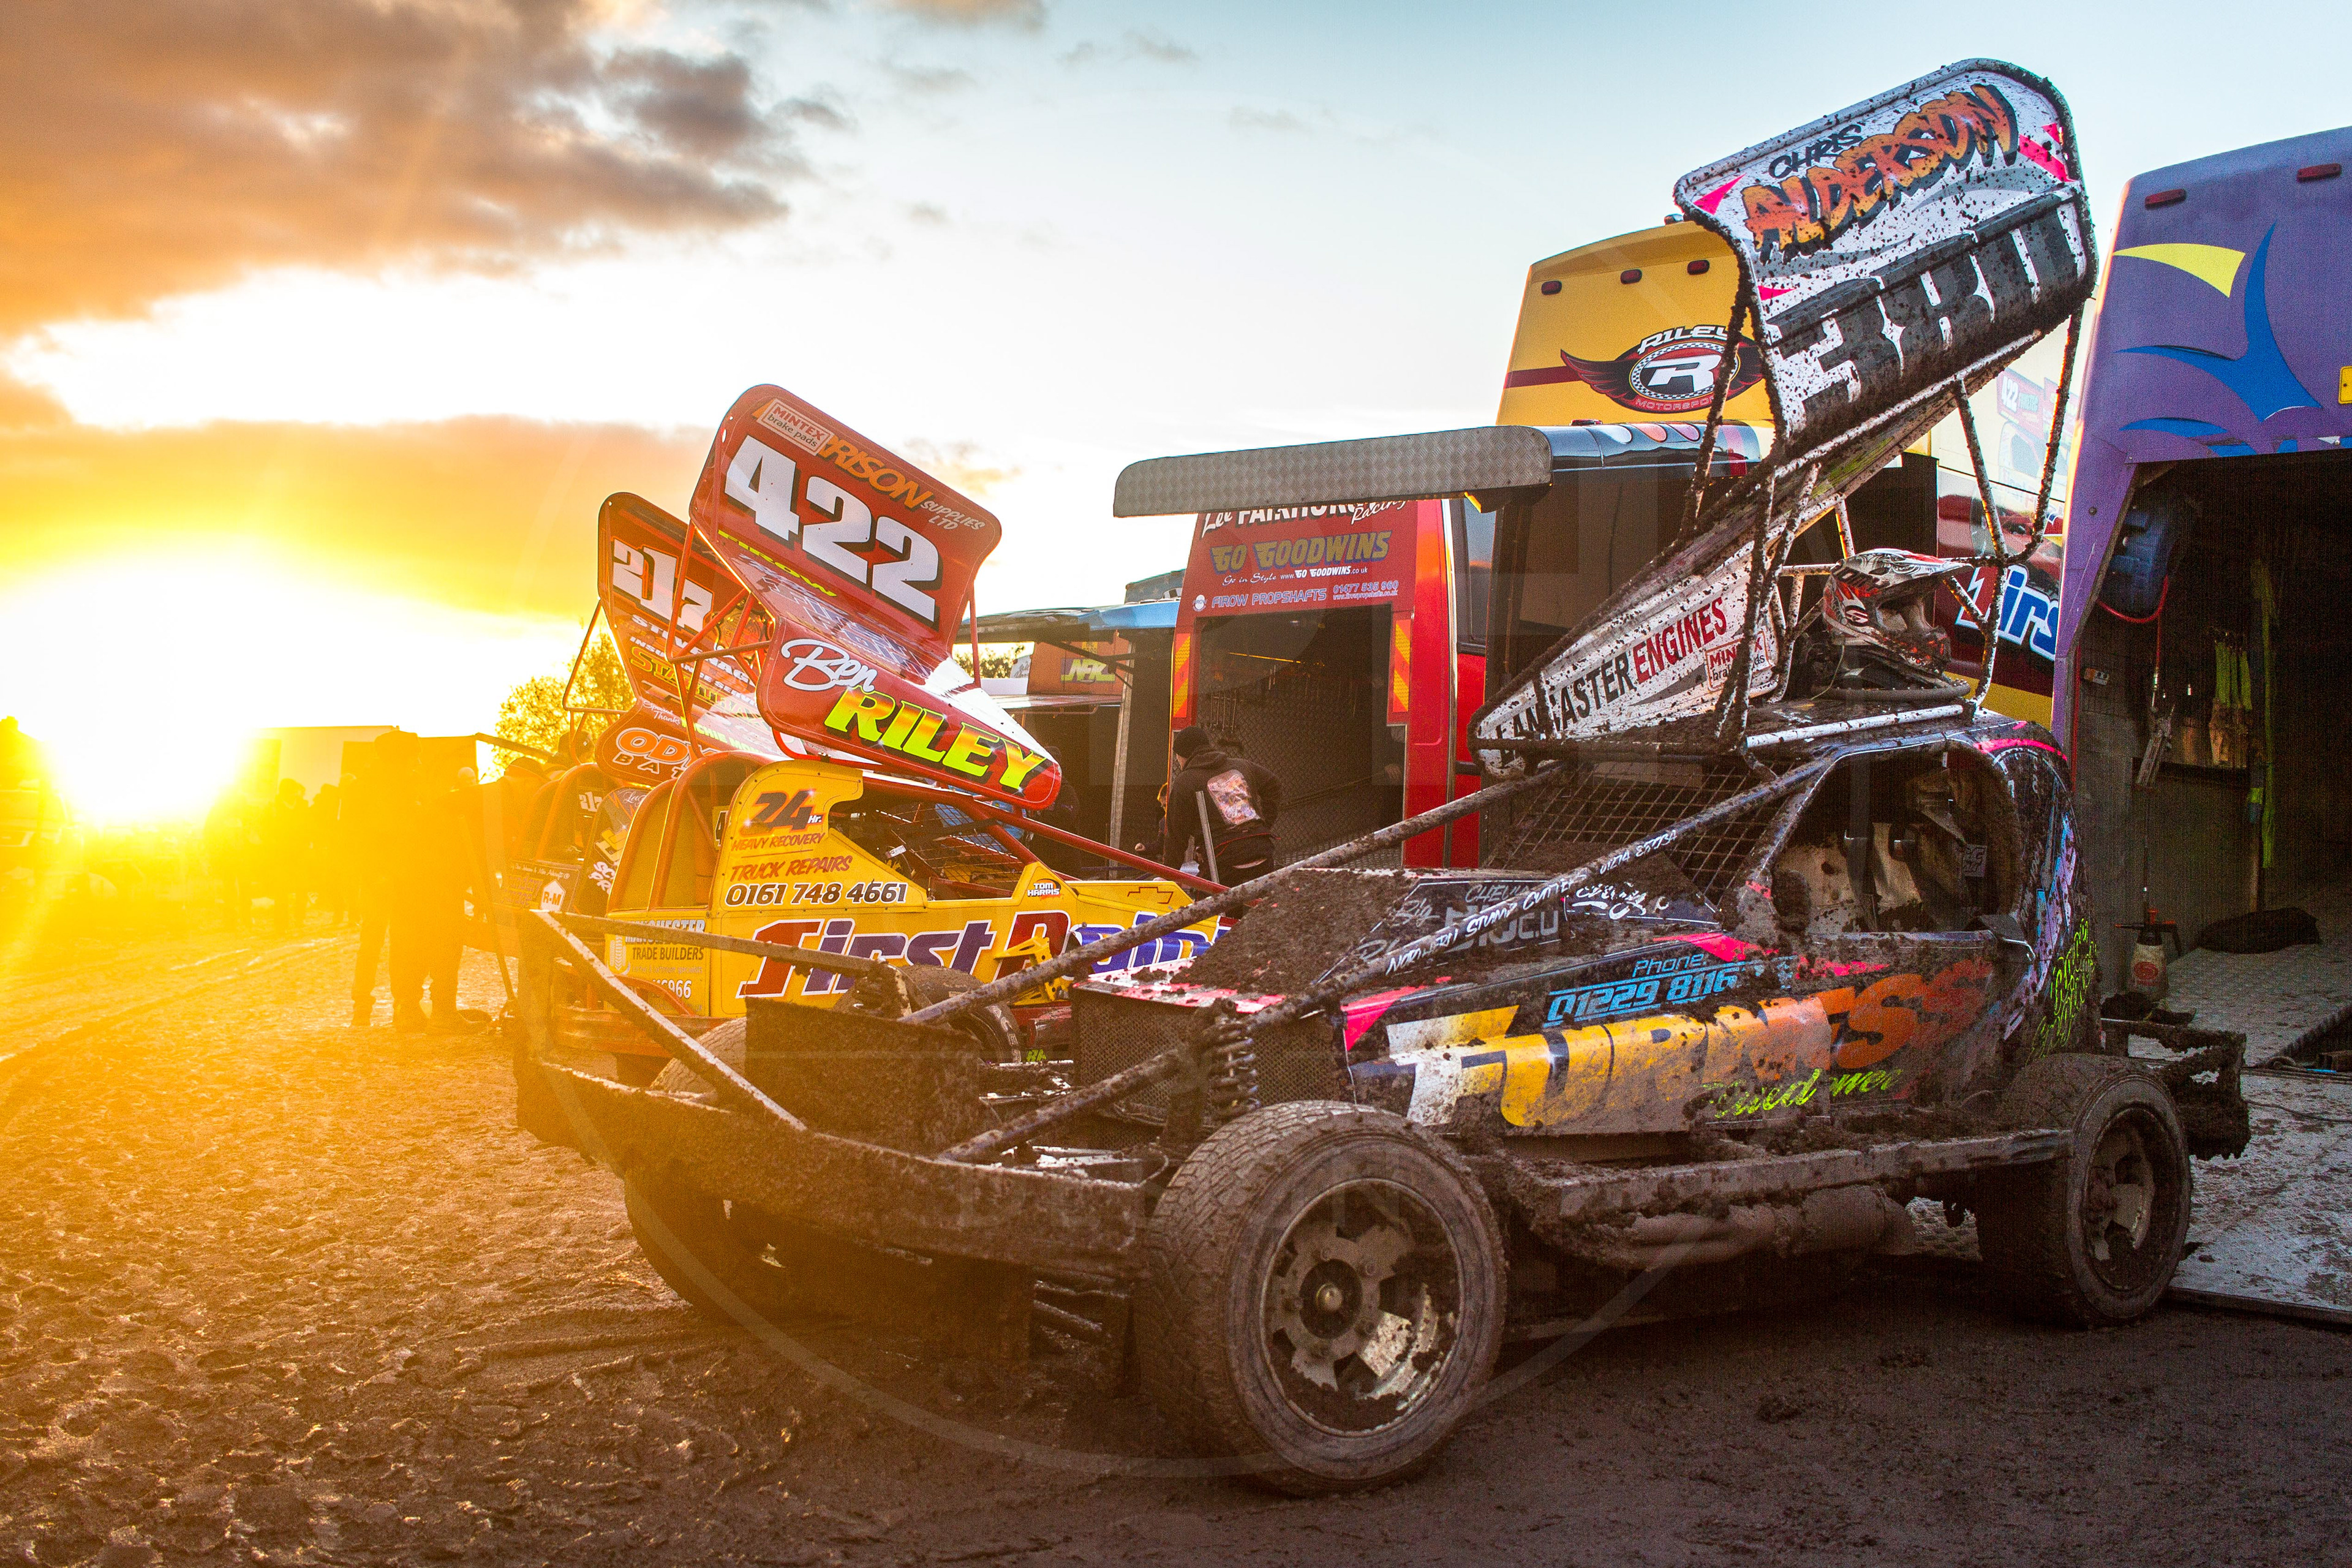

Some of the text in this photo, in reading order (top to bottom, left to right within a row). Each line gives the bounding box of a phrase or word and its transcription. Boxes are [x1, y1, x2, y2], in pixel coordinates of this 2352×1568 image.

[1768, 124, 1864, 179] CHRIS
[1741, 83, 2019, 262] ANDERSON
[767, 413, 818, 448] brake pads
[772, 405, 826, 441] MINTEX
[725, 434, 941, 624] 422
[920, 500, 986, 531] SUPPLIES
[928, 513, 959, 531] LTD
[1201, 511, 1233, 538] Lee
[1210, 530, 1393, 575] GO GOODWINS
[1212, 594, 1248, 608] FIROW
[1252, 588, 1327, 606] PROPSHAFTS
[1333, 584, 1359, 594] 01477
[1361, 582, 1379, 592] 535
[1223, 575, 1237, 587] Go
[1251, 572, 1277, 584] Style
[1954, 565, 2059, 662] Firs
[1633, 595, 1728, 684] ENGINES
[1709, 636, 1763, 670] MINX
[781, 638, 878, 692] Ben
[654, 710, 681, 726] Thanks
[824, 685, 1046, 790] RILEY
[739, 788, 816, 837] 24
[807, 814, 823, 824] Hr.
[731, 832, 826, 852] HEAVY RECOVERY
[729, 855, 853, 882] TRUCK REPAIRS
[725, 881, 909, 907] 0161 748 4661
[1027, 888, 1060, 897] HARRIS
[632, 946, 704, 961] TRADE BUILDERS
[736, 918, 997, 1000] First
[1547, 980, 1660, 1022] 01229
